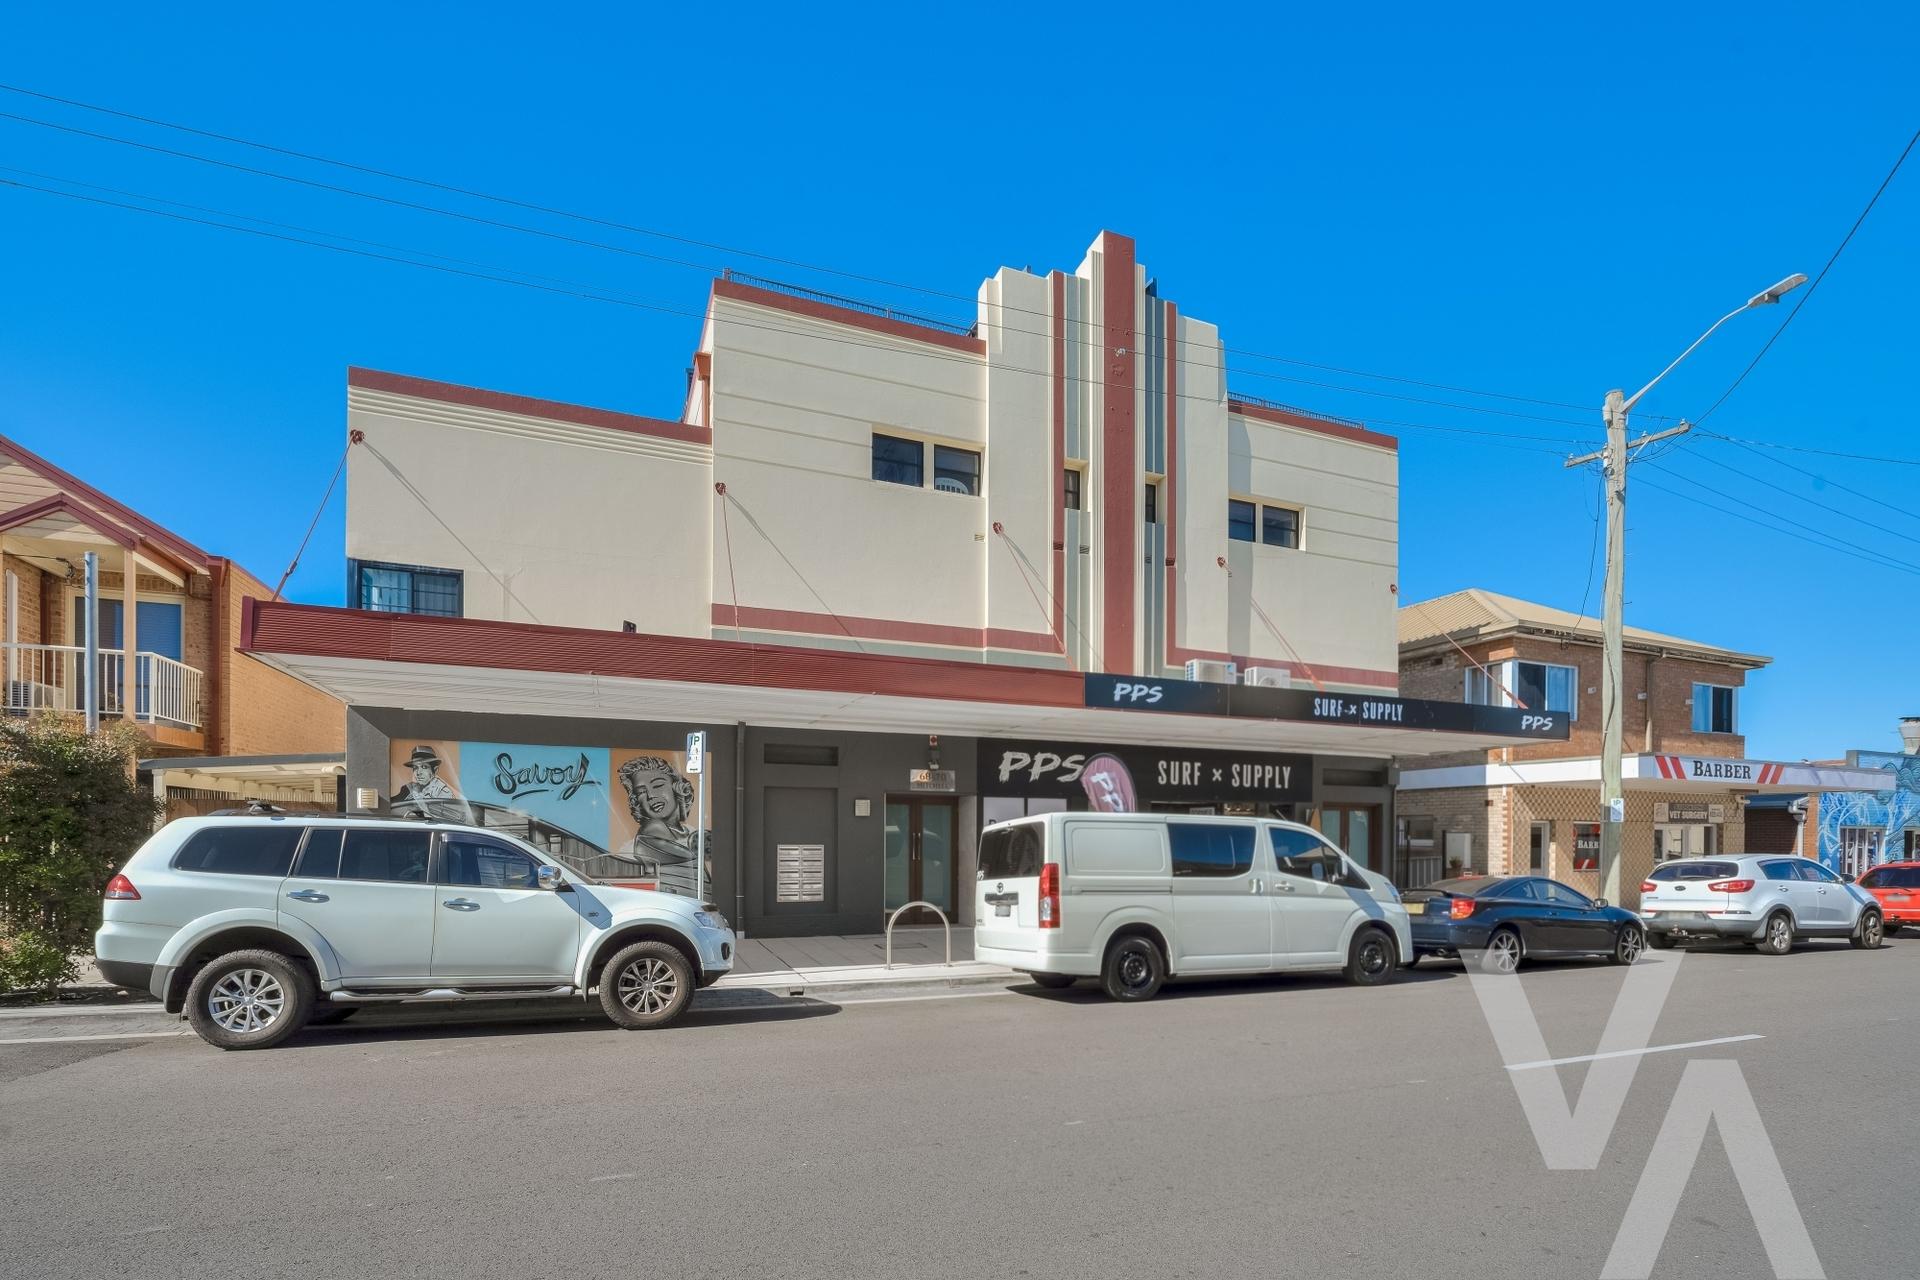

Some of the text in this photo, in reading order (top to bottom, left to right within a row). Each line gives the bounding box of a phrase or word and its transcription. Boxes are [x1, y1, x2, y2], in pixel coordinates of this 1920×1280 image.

[1113, 683, 1163, 703] PPS
[1314, 698, 1343, 717] SURF
[1362, 701, 1403, 721] SUPPLY
[1521, 715, 1553, 730] PPS
[494, 752, 601, 800] Savoy
[998, 750, 1085, 783] PPS
[1157, 760, 1201, 786] SURF
[1231, 764, 1292, 790] SUPPLY
[1693, 761, 1751, 780] BARBER
[1090, 771, 1124, 812] PP
[1577, 839, 1600, 849] BARB
